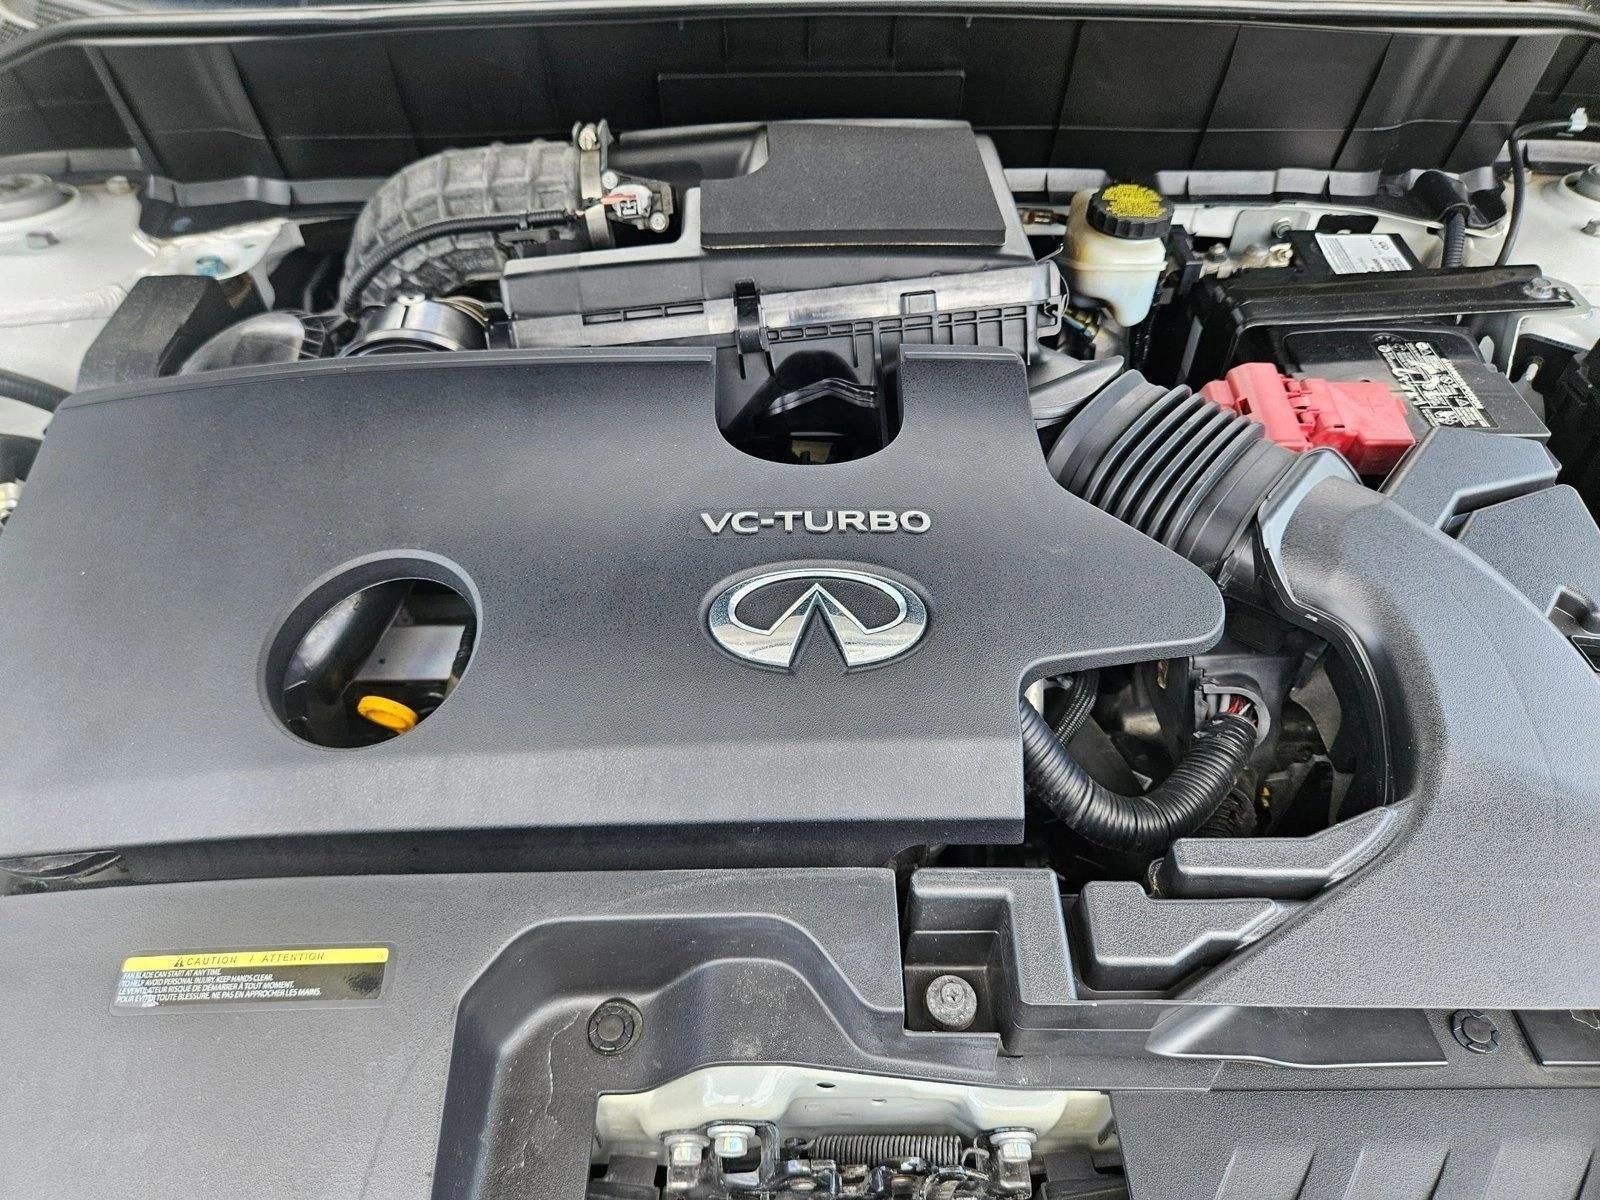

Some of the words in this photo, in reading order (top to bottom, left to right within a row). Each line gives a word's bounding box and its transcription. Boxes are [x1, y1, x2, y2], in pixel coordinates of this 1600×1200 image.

[700, 509, 932, 534] VC-TURBO
[186, 955, 238, 966] CAUTION
[261, 952, 325, 963] ATTENTION
[145, 977, 164, 987] AVOID
[164, 976, 193, 986] PERSONAL
[215, 974, 231, 984] KEEP
[231, 974, 253, 983] HANDS
[154, 970, 167, 979] CAN
[167, 969, 185, 978] START
[184, 969, 194, 977] AT
[193, 968, 207, 977] ANY
[116, 994, 135, 1003] POUR
[156, 993, 178, 1002] TOUTE
[210, 991, 222, 1000] NE
[221, 990, 235, 999] PAS
[234, 990, 245, 999] EN
[244, 988, 285, 999] APPROCHER
[285, 988, 298, 997] LES
[118, 987, 128, 996] LE
[127, 985, 168, 996] VENTILATEUR
[168, 984, 192, 994] RISQUE
[191, 984, 202, 993] DE
[201, 981, 238, 993] DÉMARRER
[244, 981, 263, 990] TOUT
